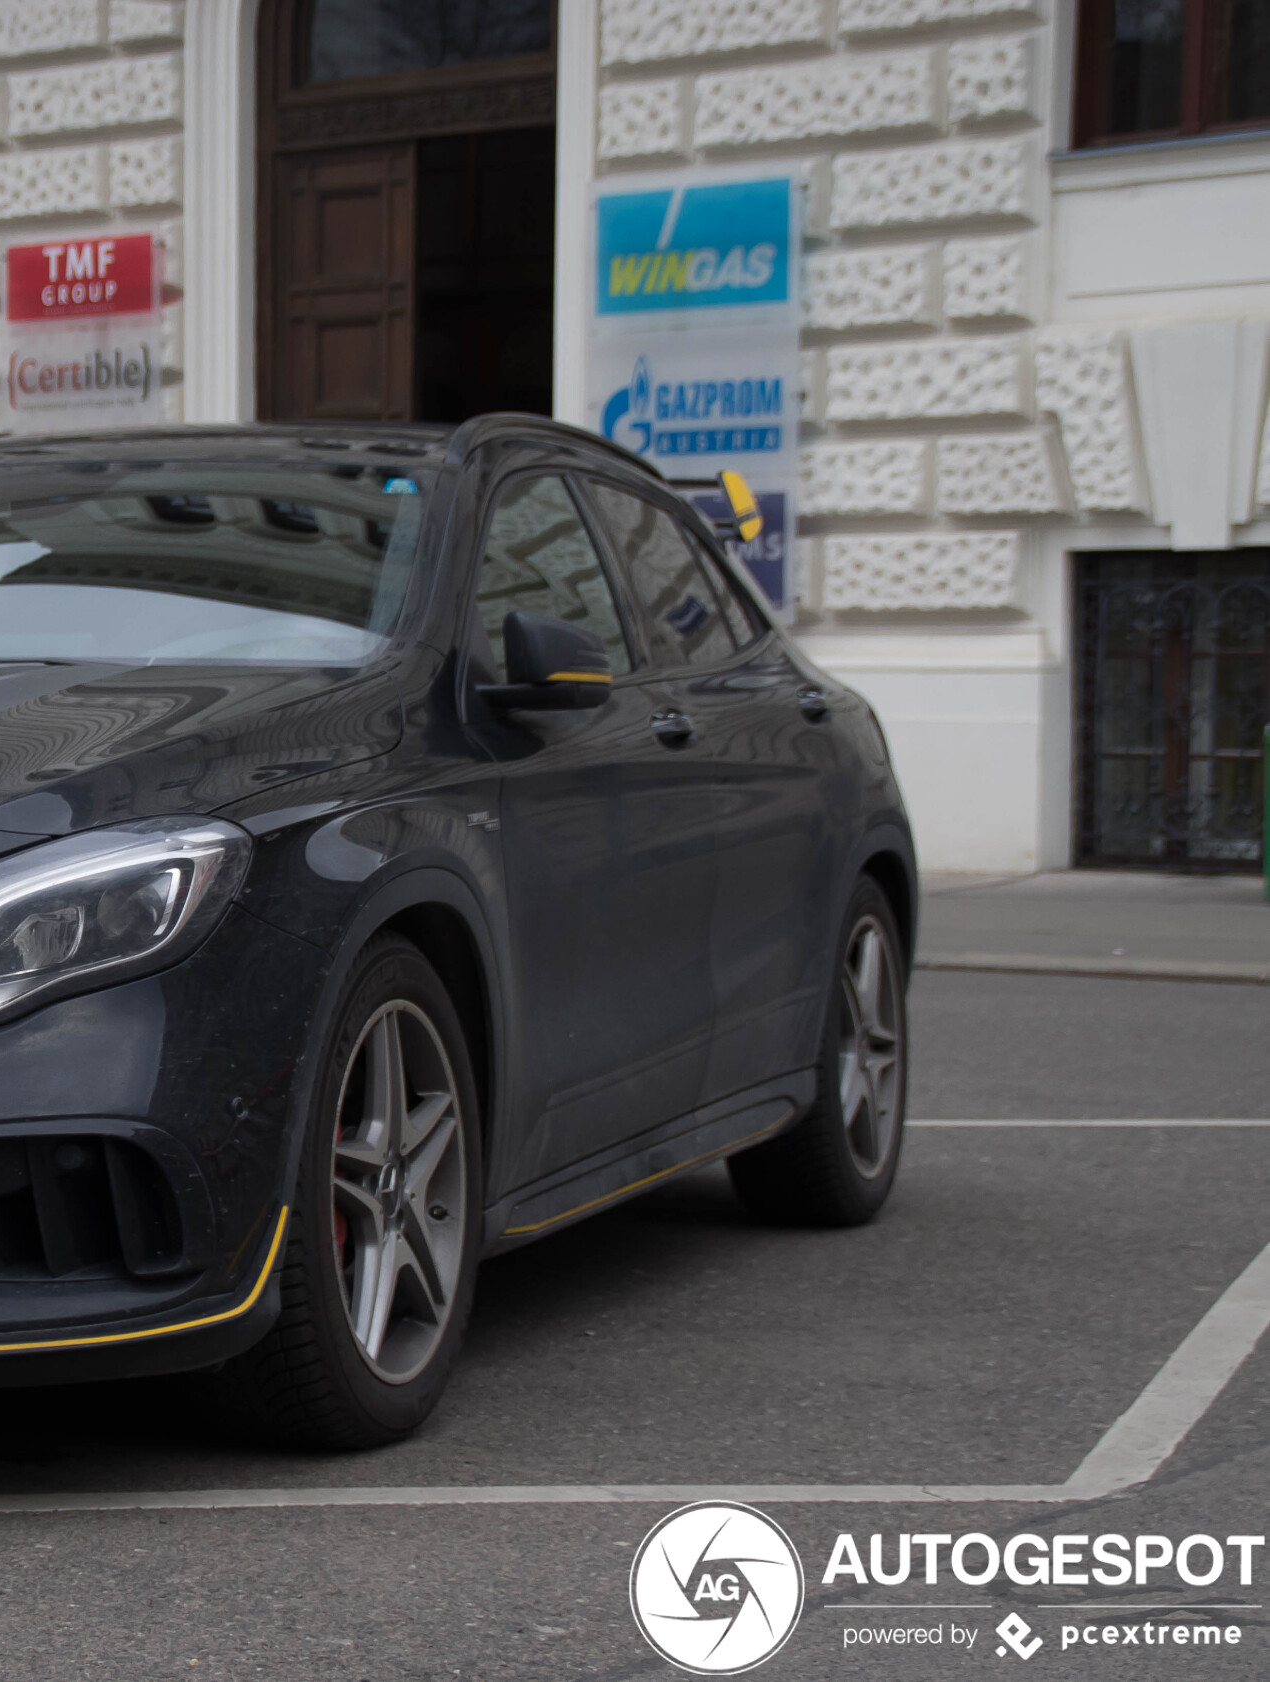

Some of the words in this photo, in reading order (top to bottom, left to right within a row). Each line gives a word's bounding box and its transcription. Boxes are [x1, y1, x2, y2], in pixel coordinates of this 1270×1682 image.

[42, 240, 116, 282] TMF
[608, 242, 778, 297] WINGAS
[41, 282, 118, 306] GROUP
[655, 377, 783, 421] GAZPROM
[657, 428, 780, 453] AUSTRIA
